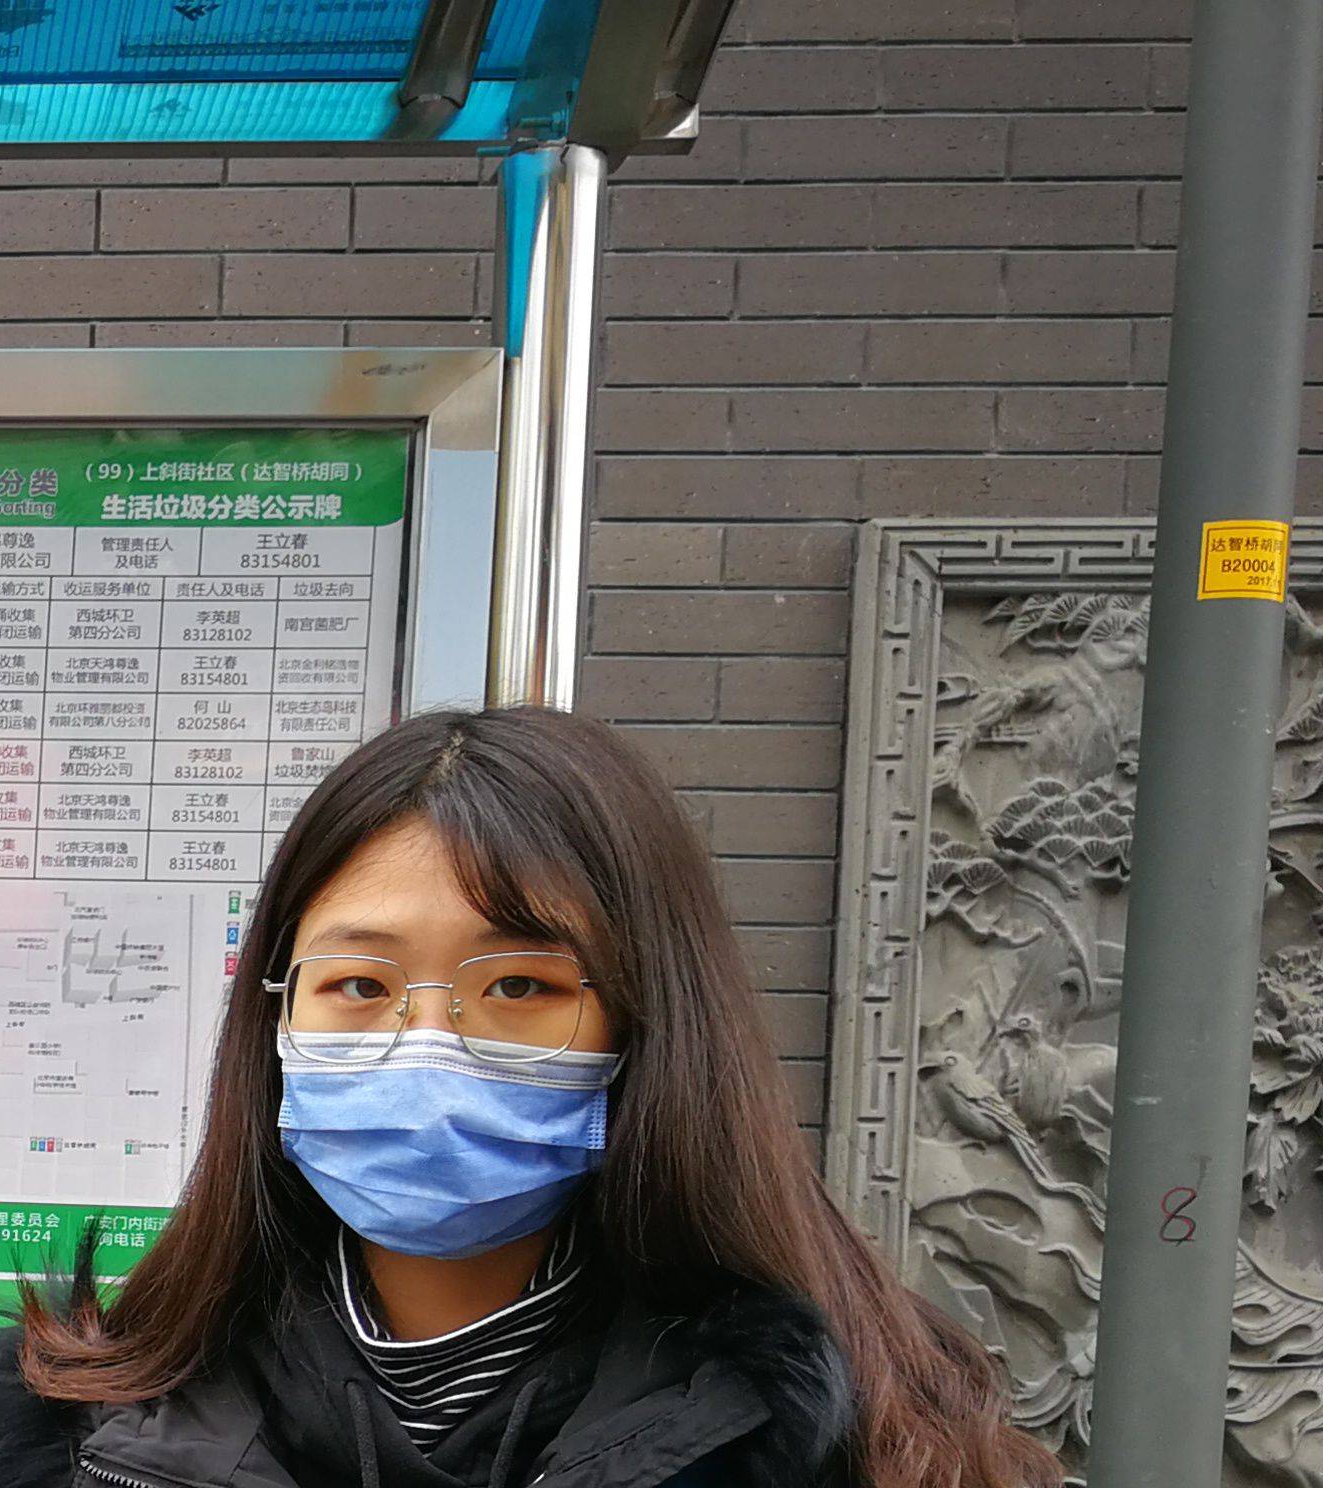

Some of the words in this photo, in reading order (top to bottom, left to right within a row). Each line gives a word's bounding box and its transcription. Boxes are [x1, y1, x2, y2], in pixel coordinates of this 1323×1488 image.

[101, 494, 342, 520] 生活垃圾分类公示牌
[100, 536, 173, 553] 管理责任人
[256, 533, 309, 551] 王立春
[114, 554, 159, 570] 及电话
[240, 554, 321, 570] 83154801
[1221, 559, 1275, 573] B20004
[63, 581, 151, 598] 收运服务单位
[176, 583, 265, 598] 责任人及电话
[294, 583, 354, 597] 垃圾去向
[76, 608, 135, 623] 西城环卫
[69, 624, 141, 641] 第四分公司
[183, 629, 252, 642] 83128102
[194, 656, 237, 670] 王立春
[52, 671, 149, 685] 物业管理有限公司
[181, 673, 248, 686] 83154801
[177, 717, 246, 730] 82025864
[69, 746, 126, 760] 西城环卫
[61, 762, 133, 777] 第四分公司
[174, 766, 243, 779] 83128102
[185, 793, 229, 808] 王立春
[43, 808, 141, 821] 物业管理有限公司
[171, 810, 240, 823] 83154801
[182, 841, 225, 855] 王立春
[41, 856, 138, 868] 物业管理有限公司
[169, 858, 236, 871] 83154801
